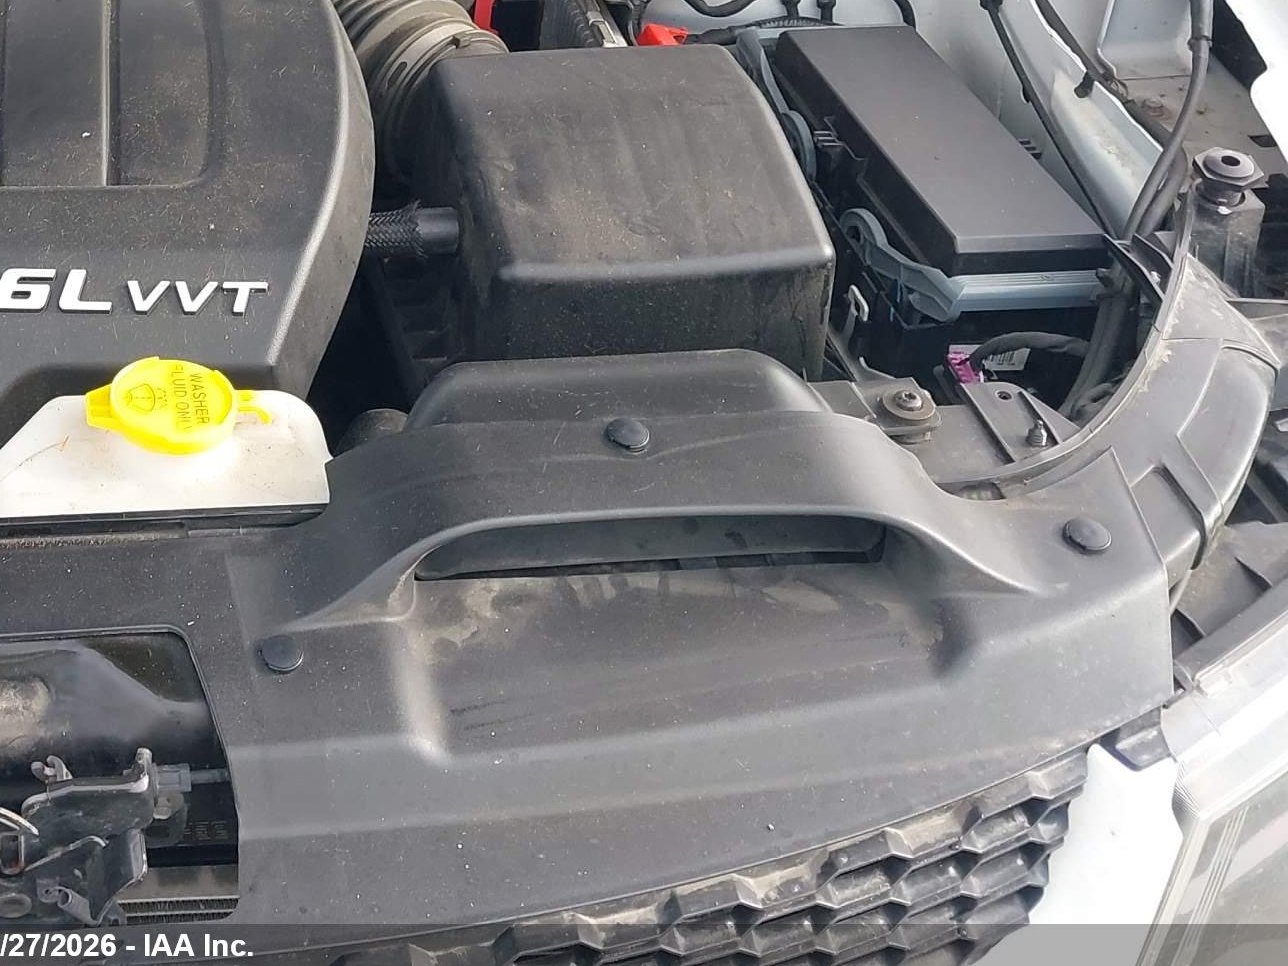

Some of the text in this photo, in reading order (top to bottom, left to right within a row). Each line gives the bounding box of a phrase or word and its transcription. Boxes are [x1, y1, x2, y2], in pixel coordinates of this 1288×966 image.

[126, 280, 269, 317] VVT
[171, 364, 187, 398] FLUID
[190, 373, 210, 424] WASHER
